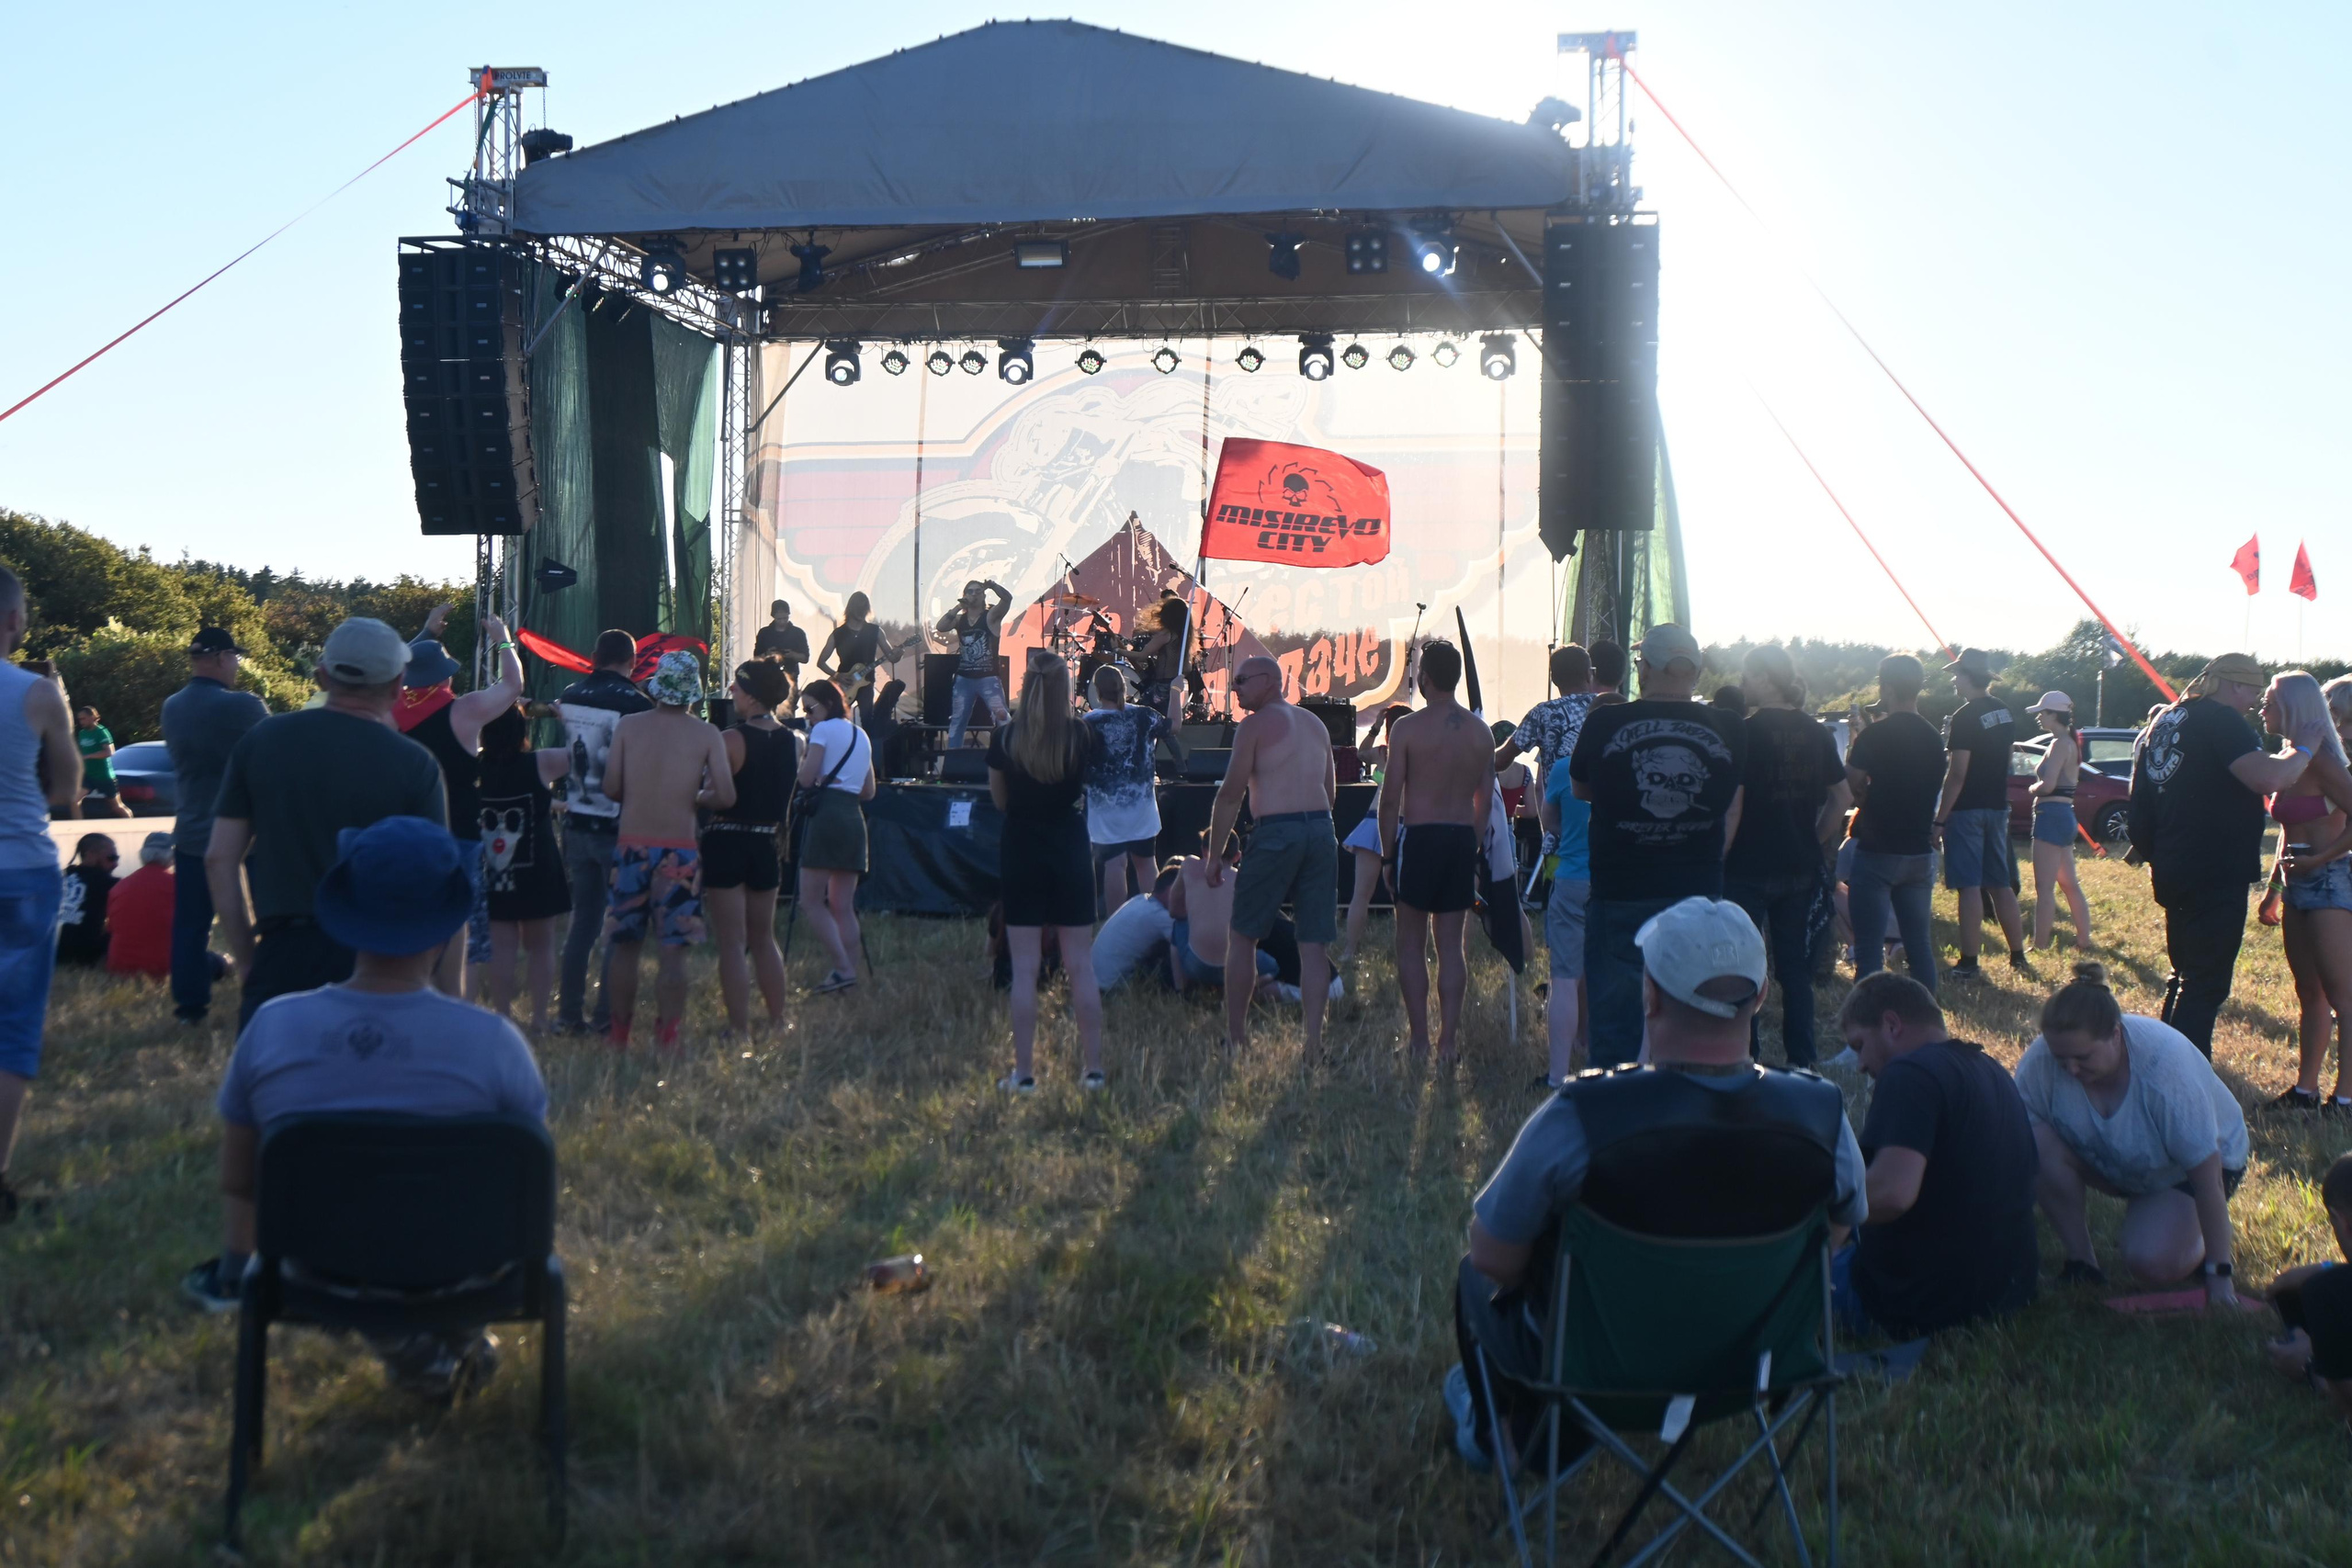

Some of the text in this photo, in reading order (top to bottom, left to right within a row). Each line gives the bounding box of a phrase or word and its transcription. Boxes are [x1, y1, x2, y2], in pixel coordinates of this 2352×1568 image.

[494, 71, 531, 80] PROLYTE
[1216, 504, 1381, 539] MISIREVO
[1257, 531, 1332, 553] CITY
